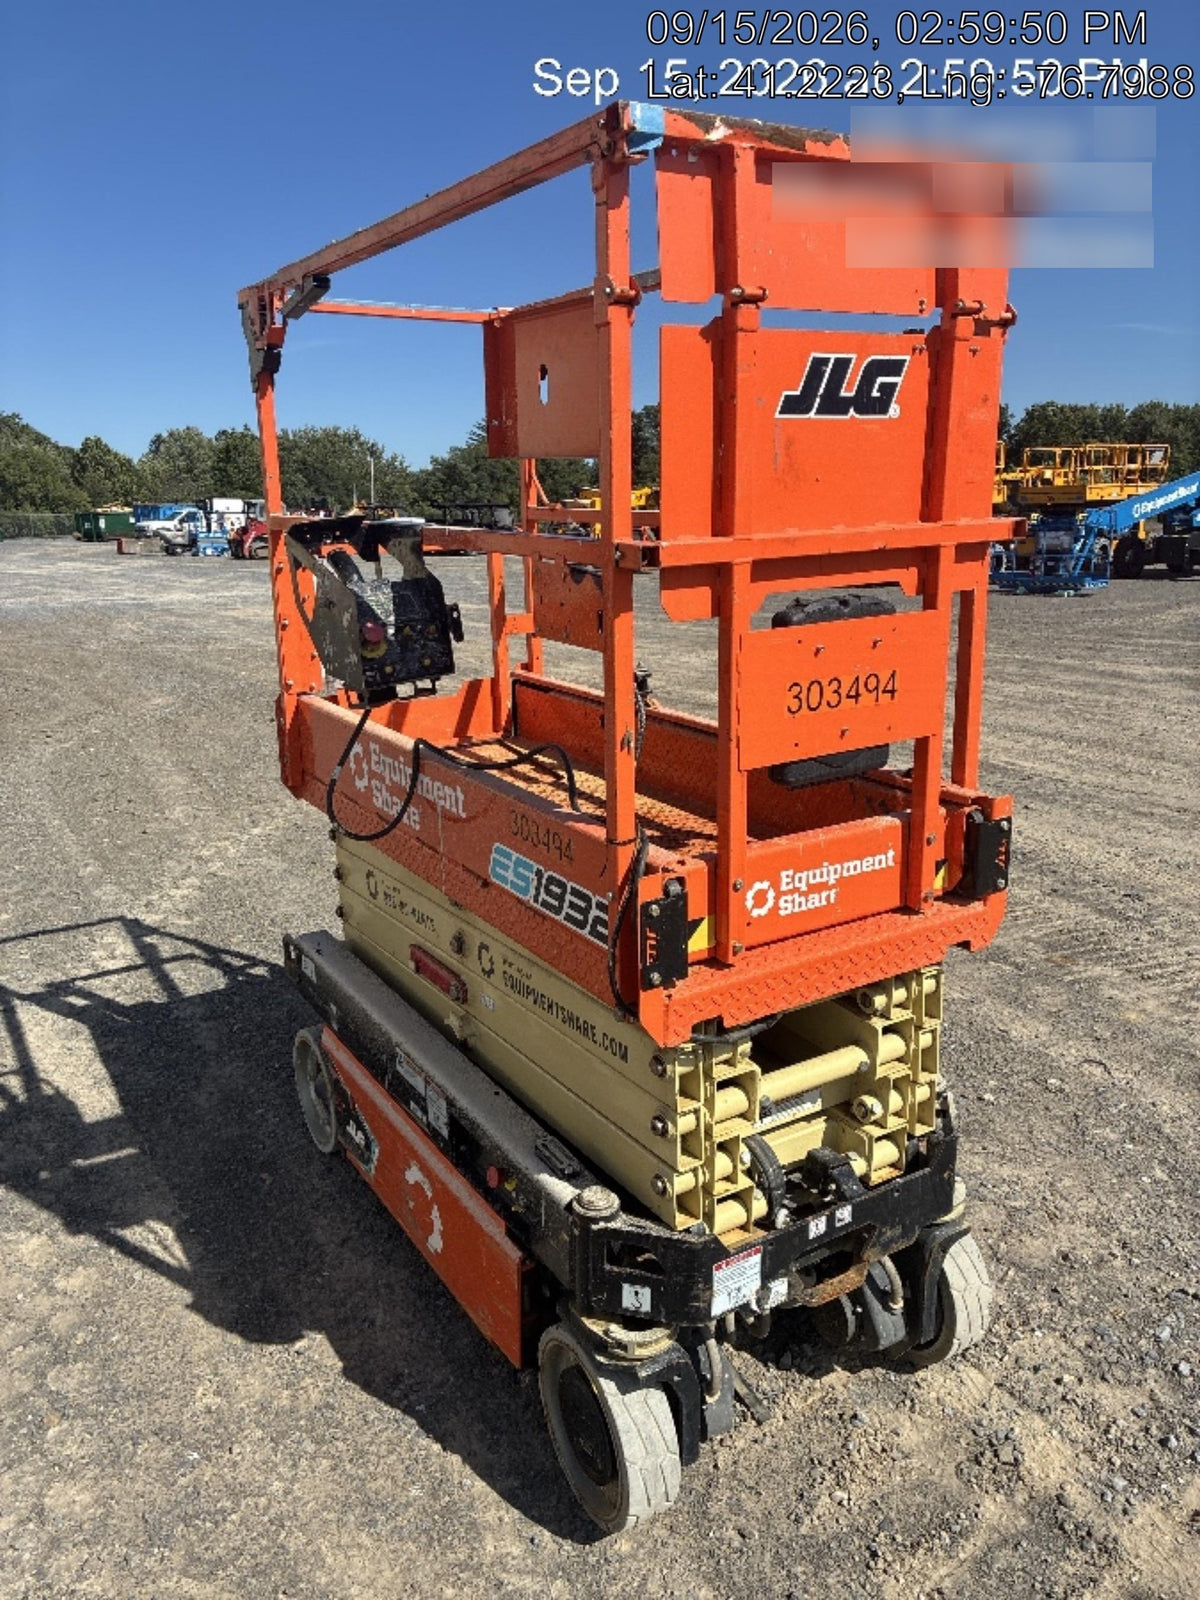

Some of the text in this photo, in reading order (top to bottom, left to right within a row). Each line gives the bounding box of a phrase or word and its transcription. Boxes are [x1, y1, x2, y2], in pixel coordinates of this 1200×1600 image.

[775, 352, 910, 419] JLG
[786, 669, 898, 715] 303494
[511, 810, 573, 863] 303494
[489, 842, 609, 950] ES1932
[780, 849, 895, 891] Equipment
